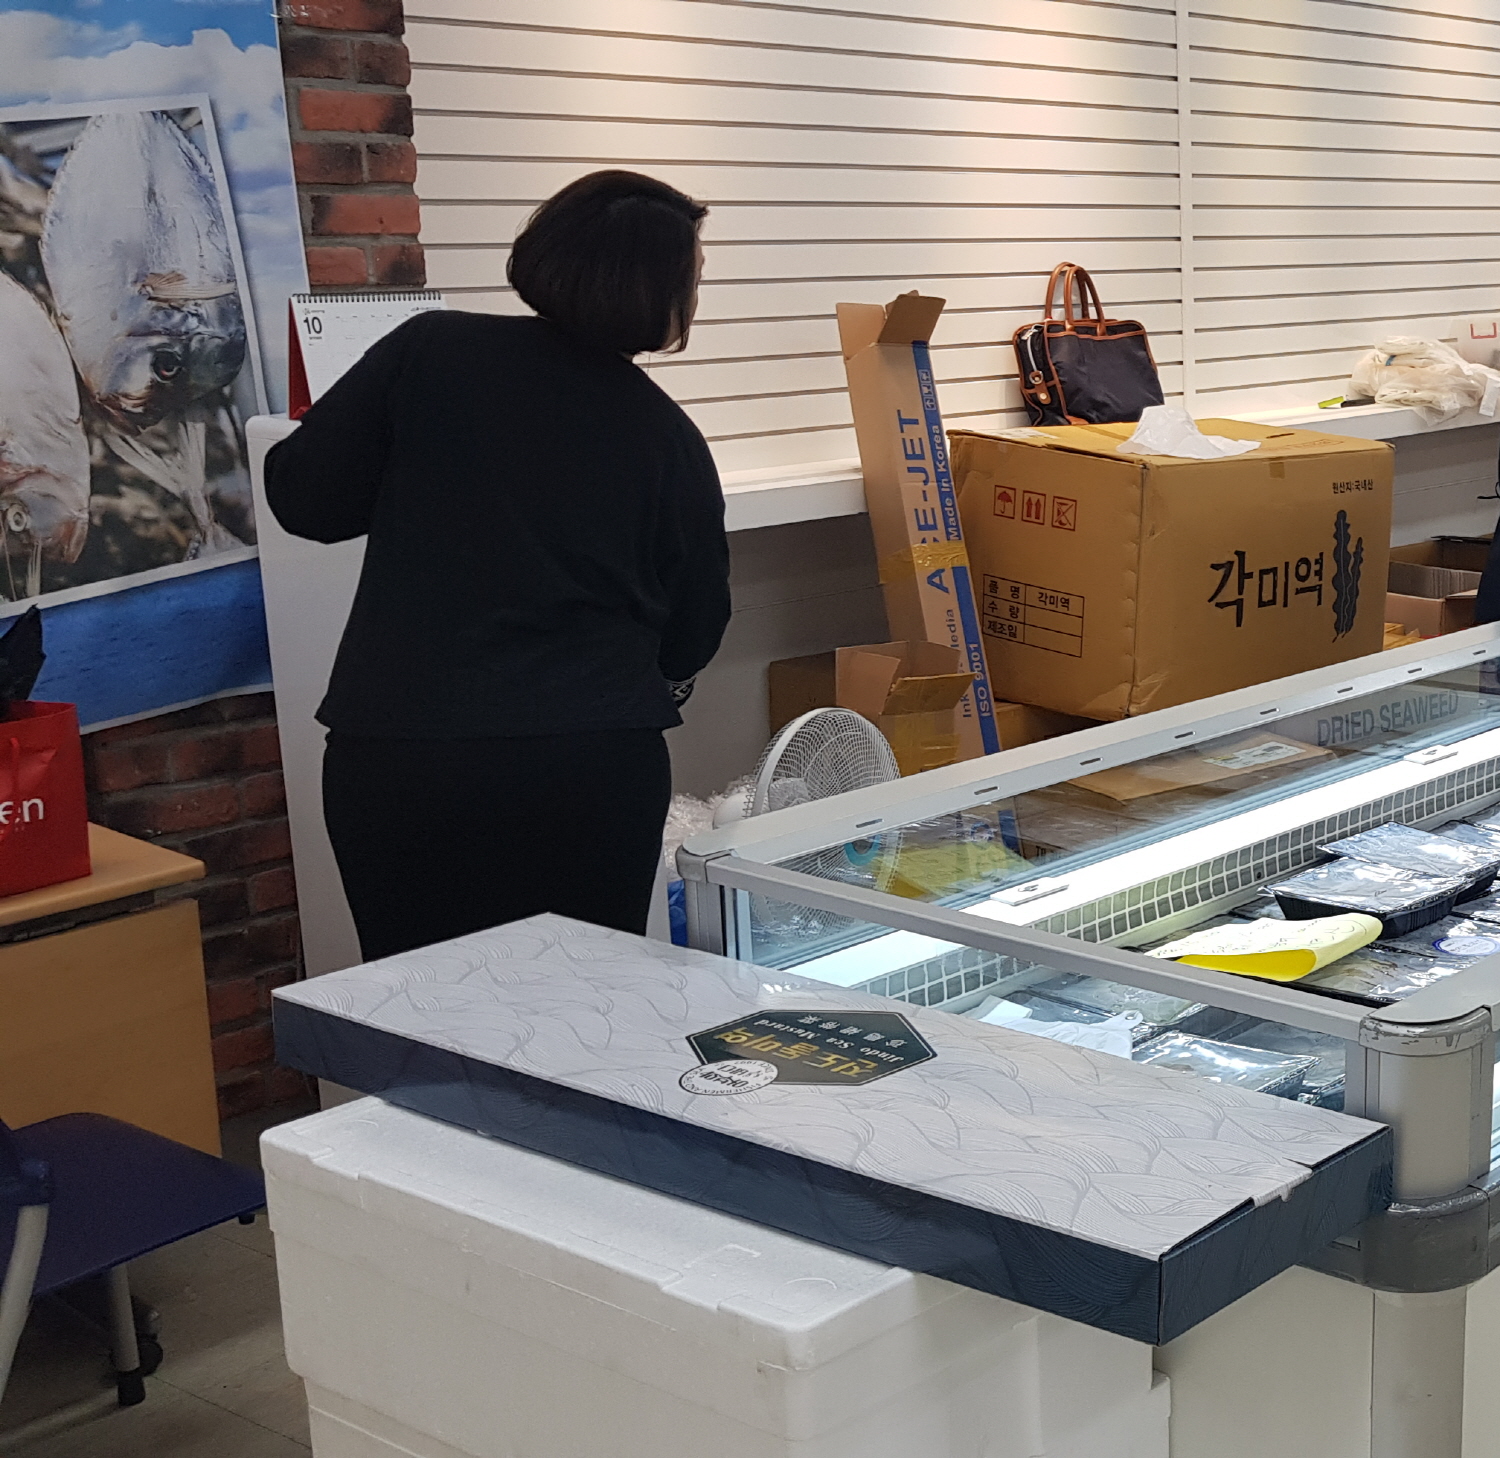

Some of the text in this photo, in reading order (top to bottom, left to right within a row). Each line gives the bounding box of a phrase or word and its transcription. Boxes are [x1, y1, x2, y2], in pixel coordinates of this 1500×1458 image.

[303, 316, 323, 335] 10
[931, 424, 946, 473] Korea
[896, 409, 950, 595] AE-JET
[945, 498, 962, 541] Made
[988, 600, 999, 613] 수
[1010, 586, 1020, 599] 명
[1037, 591, 1070, 611] 각미역
[1207, 550, 1324, 628] 각미역
[945, 609, 959, 648] edia
[987, 620, 1018, 639] 제조일
[969, 643, 991, 717] ISO 9001
[1317, 690, 1459, 747] DRIED SEAWEED
[753, 1019, 905, 1063] Jindo Sea Mustard
